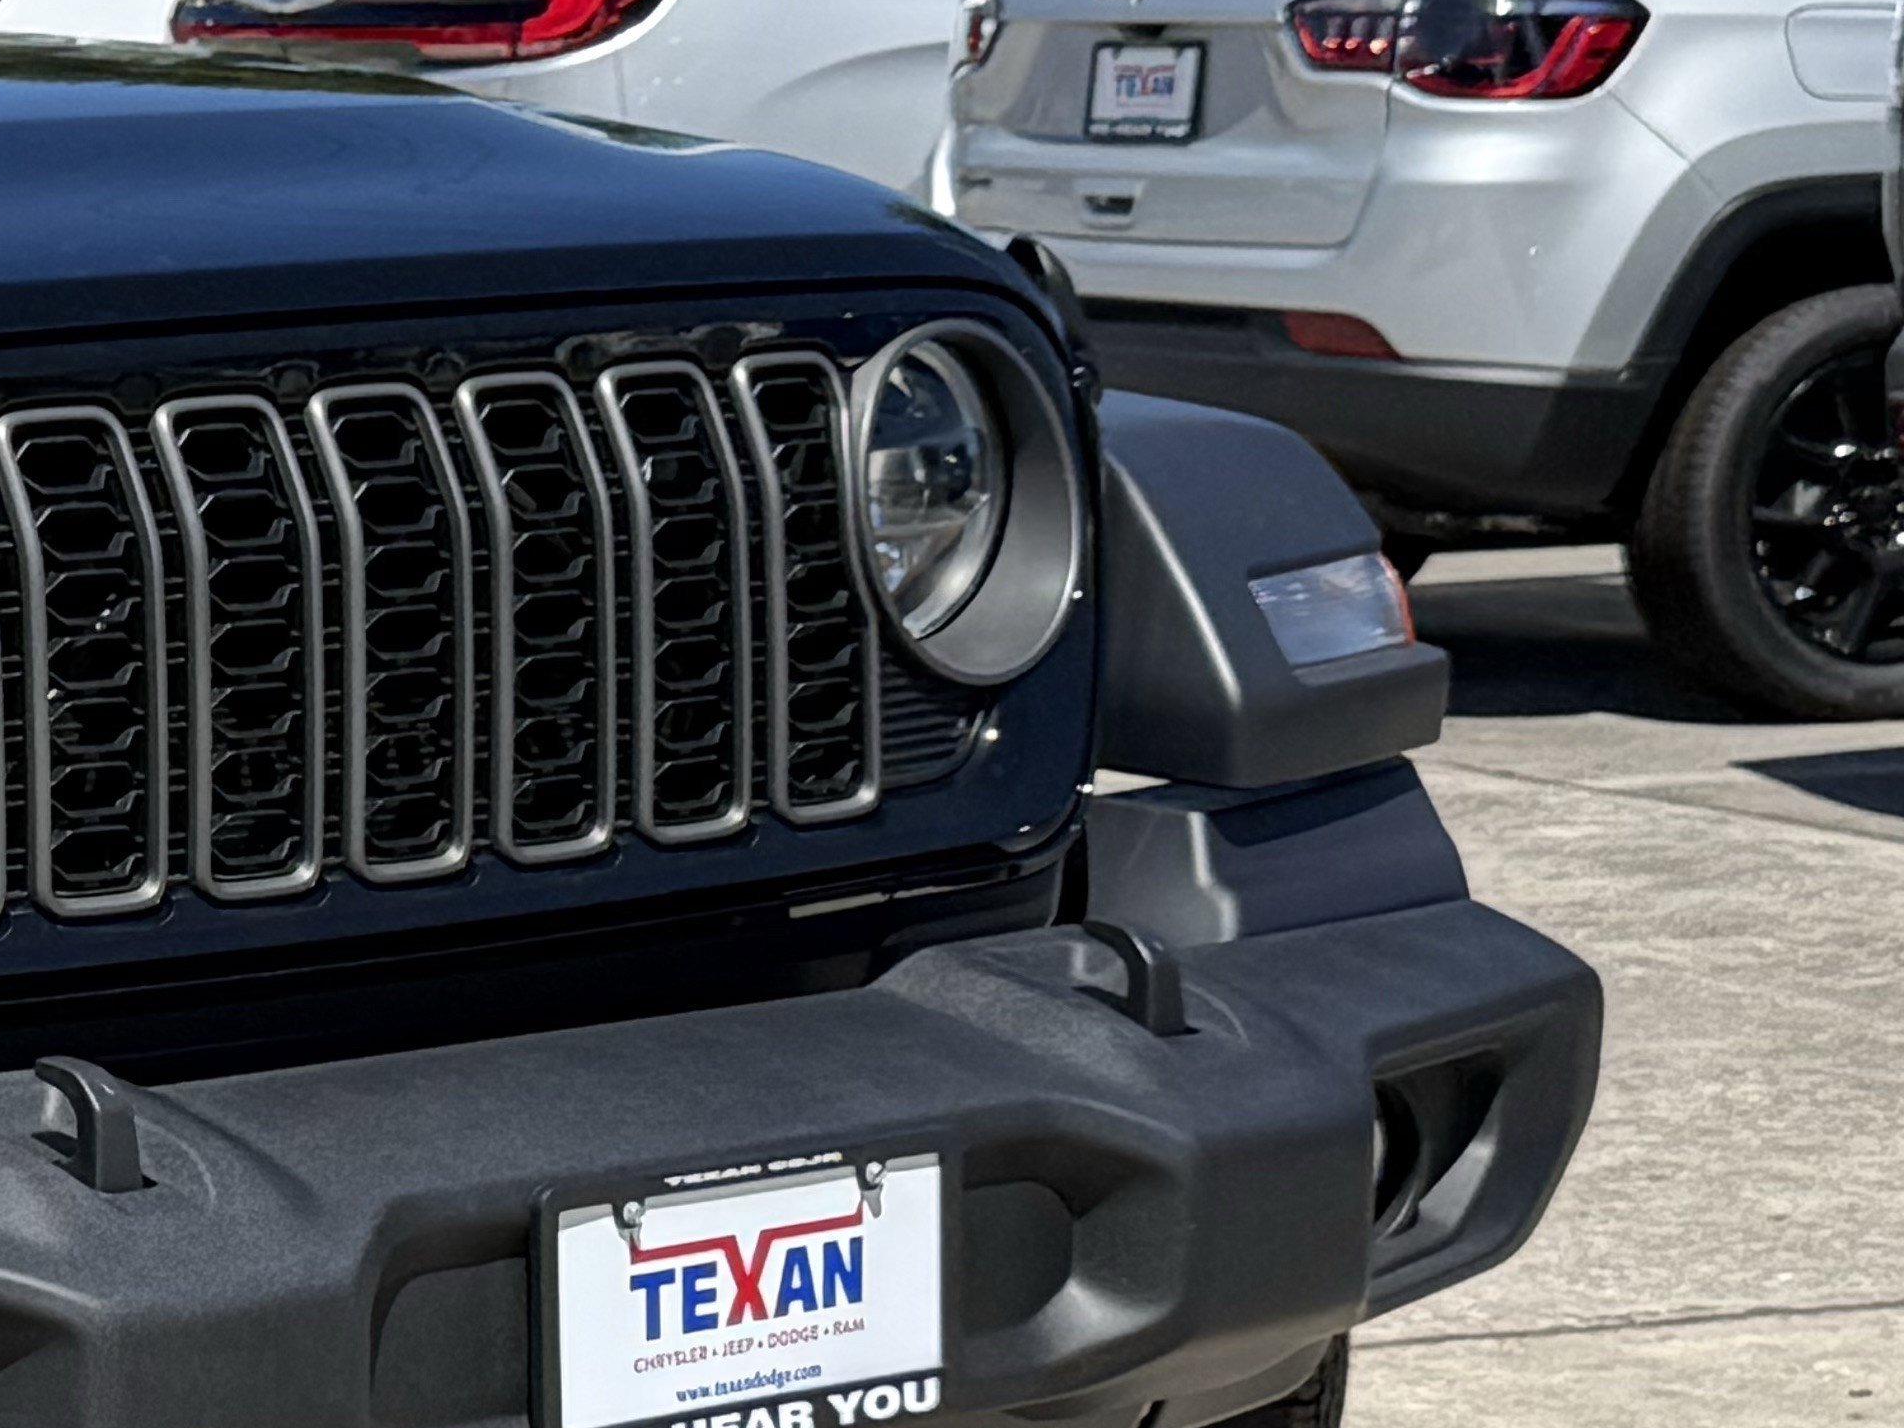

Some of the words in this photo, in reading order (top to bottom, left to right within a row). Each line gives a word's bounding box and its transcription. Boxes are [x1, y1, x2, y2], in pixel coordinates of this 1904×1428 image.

[664, 1163, 762, 1187] TEXAN
[629, 1220, 863, 1342] TEXAN
[721, 1337, 754, 1358] JEEP
[767, 1325, 819, 1349] DODGE
[833, 1318, 865, 1335] RAM
[827, 1376, 941, 1426] YOU
